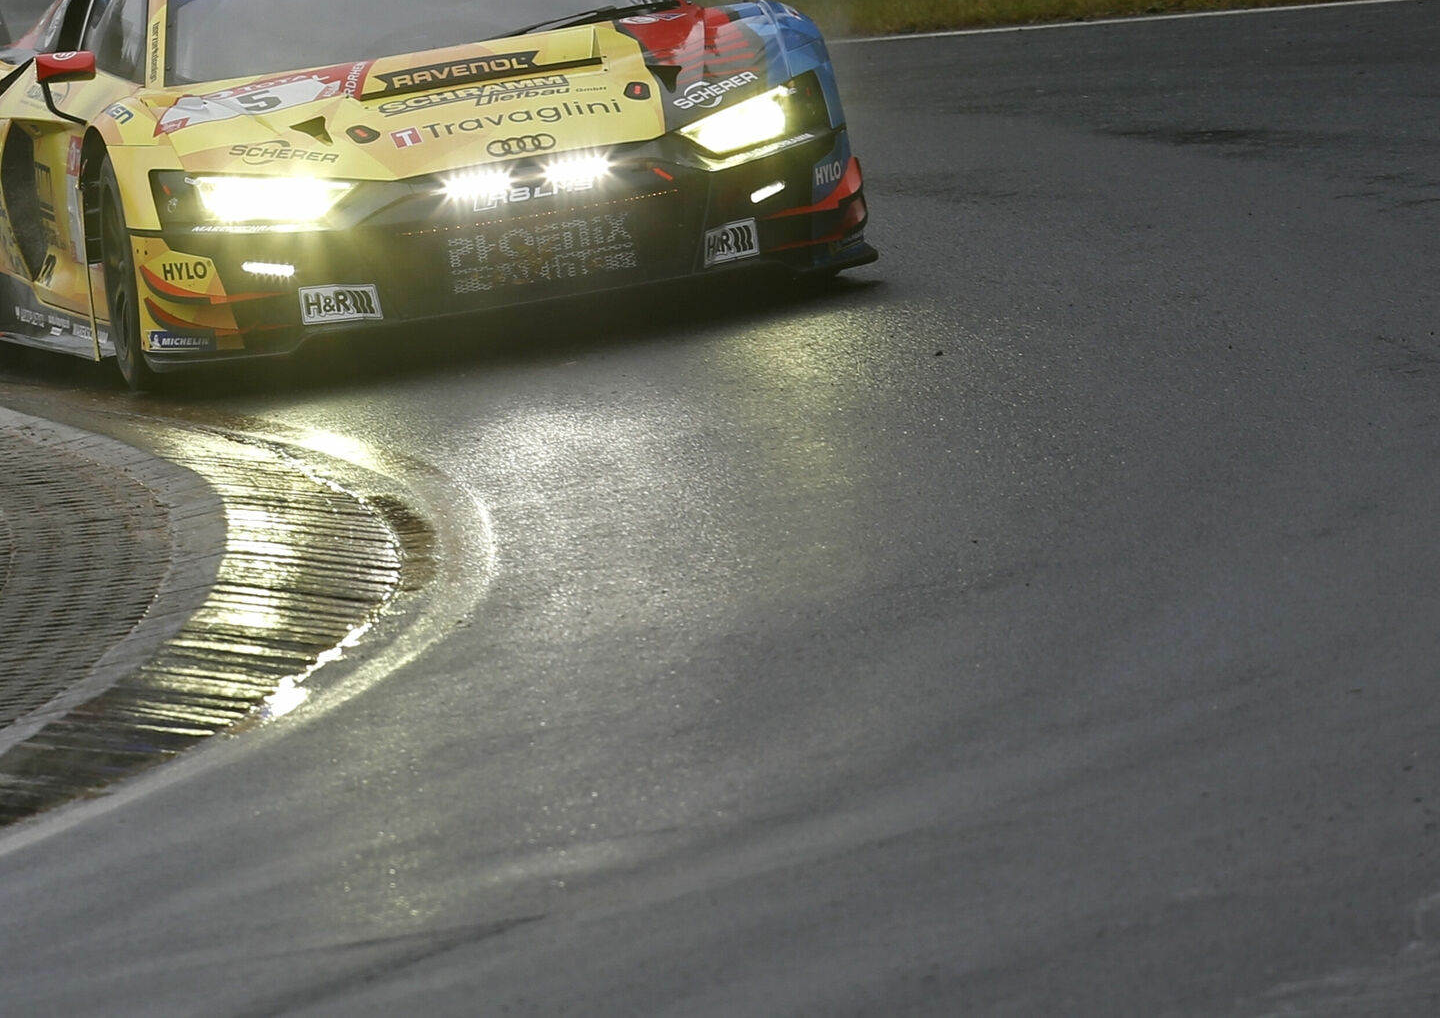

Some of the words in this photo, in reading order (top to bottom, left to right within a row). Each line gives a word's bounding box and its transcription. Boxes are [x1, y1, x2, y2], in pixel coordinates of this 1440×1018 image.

[392, 58, 529, 89] RAVENOL
[236, 90, 282, 112] 5
[378, 75, 569, 117] SCHRAMM
[475, 86, 570, 107] Tiefbau
[673, 71, 759, 110] SCHERER
[423, 99, 622, 139] Travaglini
[229, 144, 340, 164] SCHERER
[815, 160, 843, 186] HYLO
[162, 261, 208, 281] HYLO
[304, 292, 351, 317] H&R
[161, 336, 209, 348] MICHELIN
